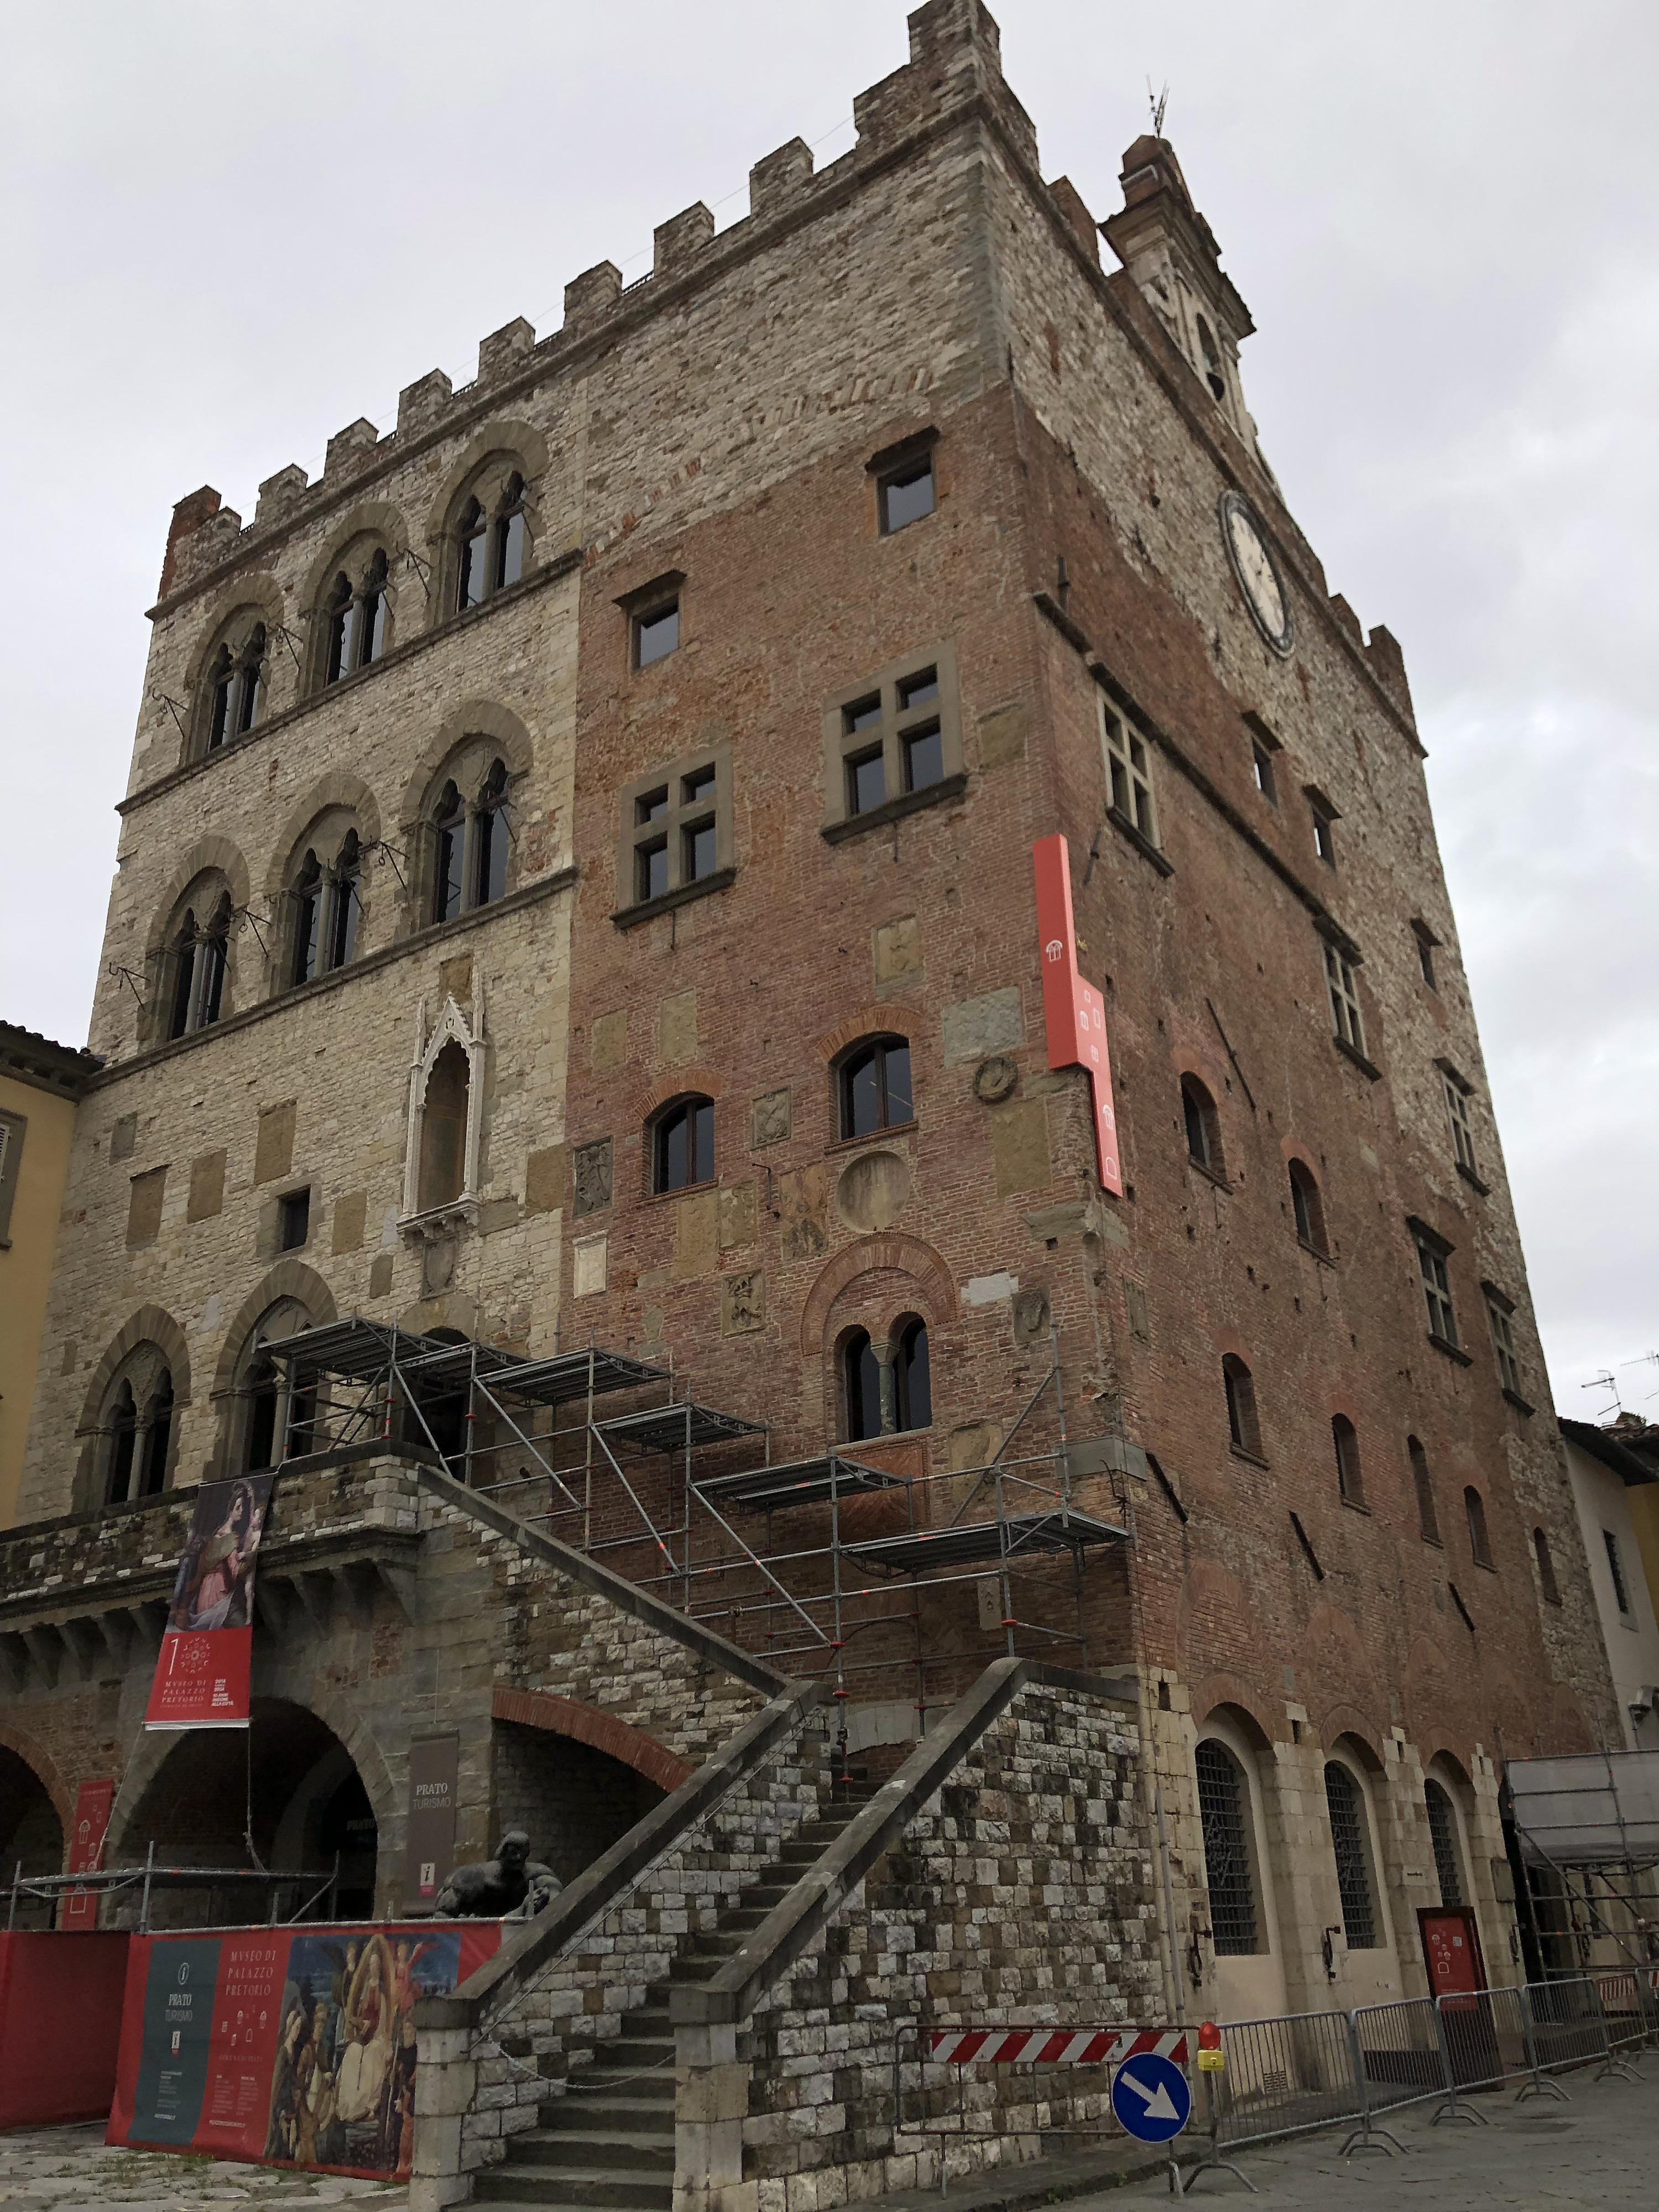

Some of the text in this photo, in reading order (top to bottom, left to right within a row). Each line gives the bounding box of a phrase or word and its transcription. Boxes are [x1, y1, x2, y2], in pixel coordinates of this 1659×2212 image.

[416, 1782, 448, 1796] PRATO
[412, 1797, 451, 1809] TURISMO
[265, 1950, 276, 1961] DI
[227, 1966, 274, 1979] PALAZZO
[225, 1984, 271, 1996] PRETORIO
[168, 1993, 192, 2006] PRATO
[165, 2009, 192, 2022] TURISMO
